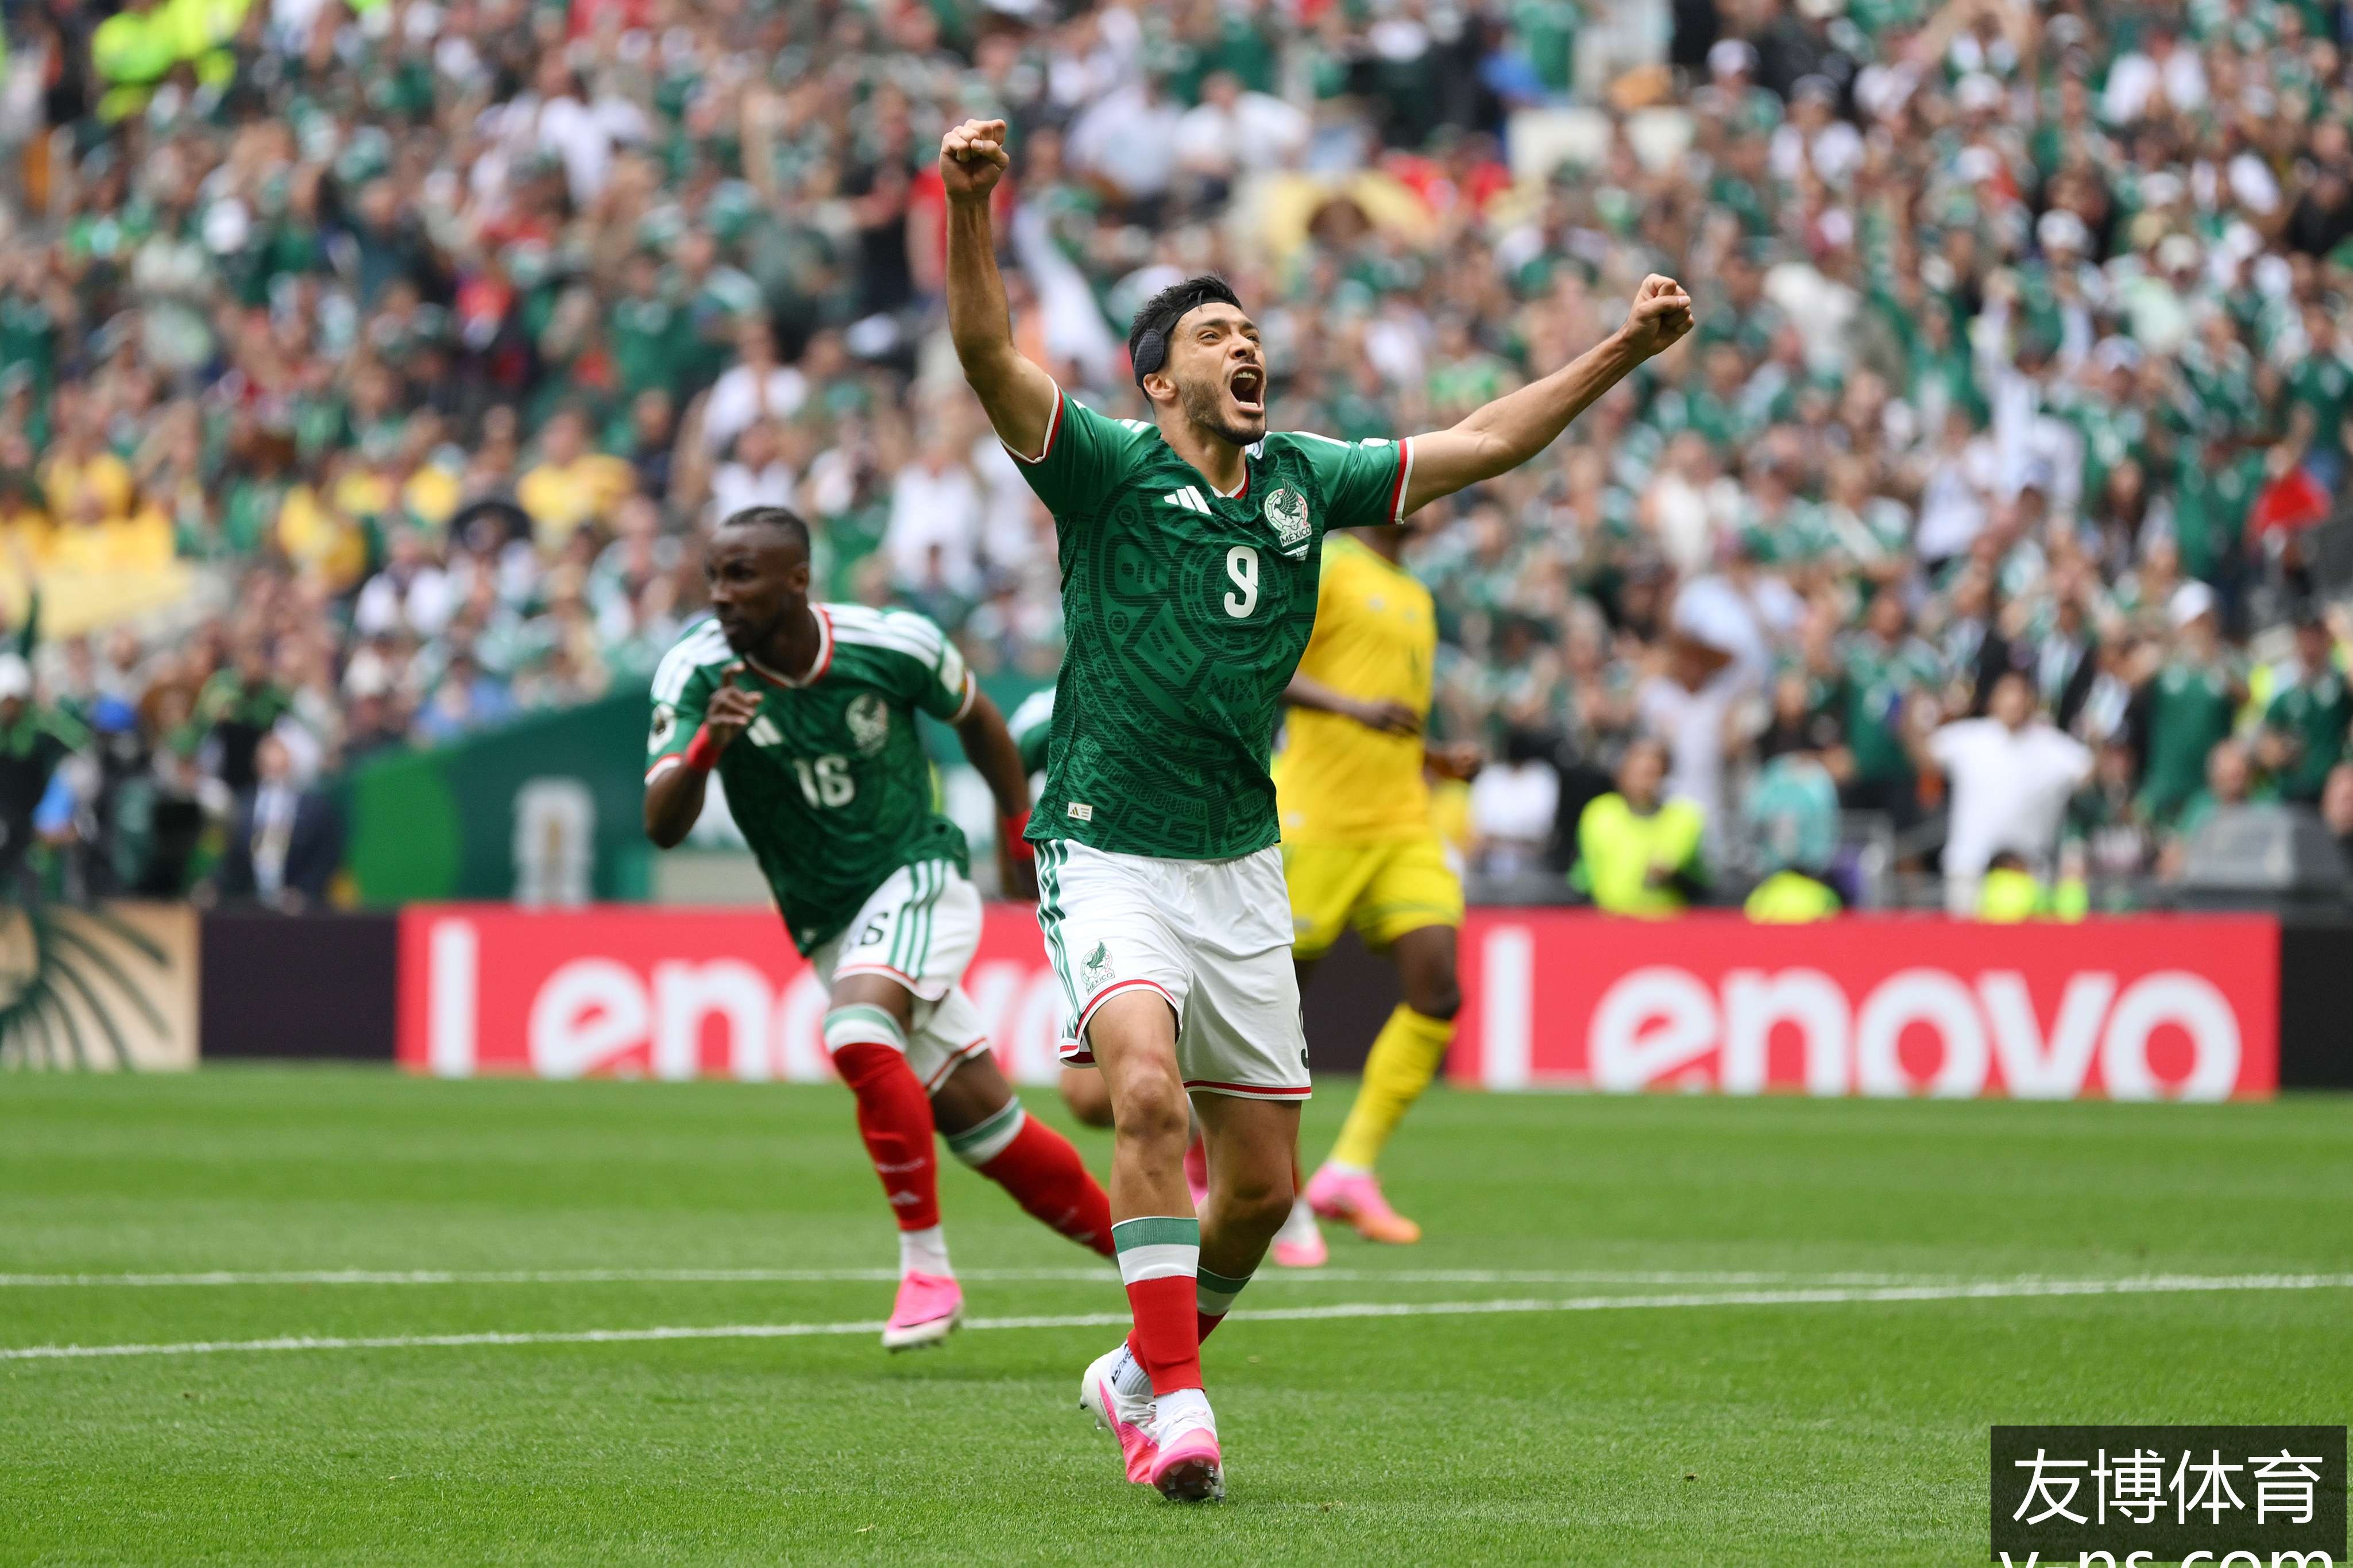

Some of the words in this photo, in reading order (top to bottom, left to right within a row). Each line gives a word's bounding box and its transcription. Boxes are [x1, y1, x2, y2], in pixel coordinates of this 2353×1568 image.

[1224, 546, 1259, 618] 9
[795, 755, 855, 809] 16
[1480, 925, 2242, 1102] Lenovo
